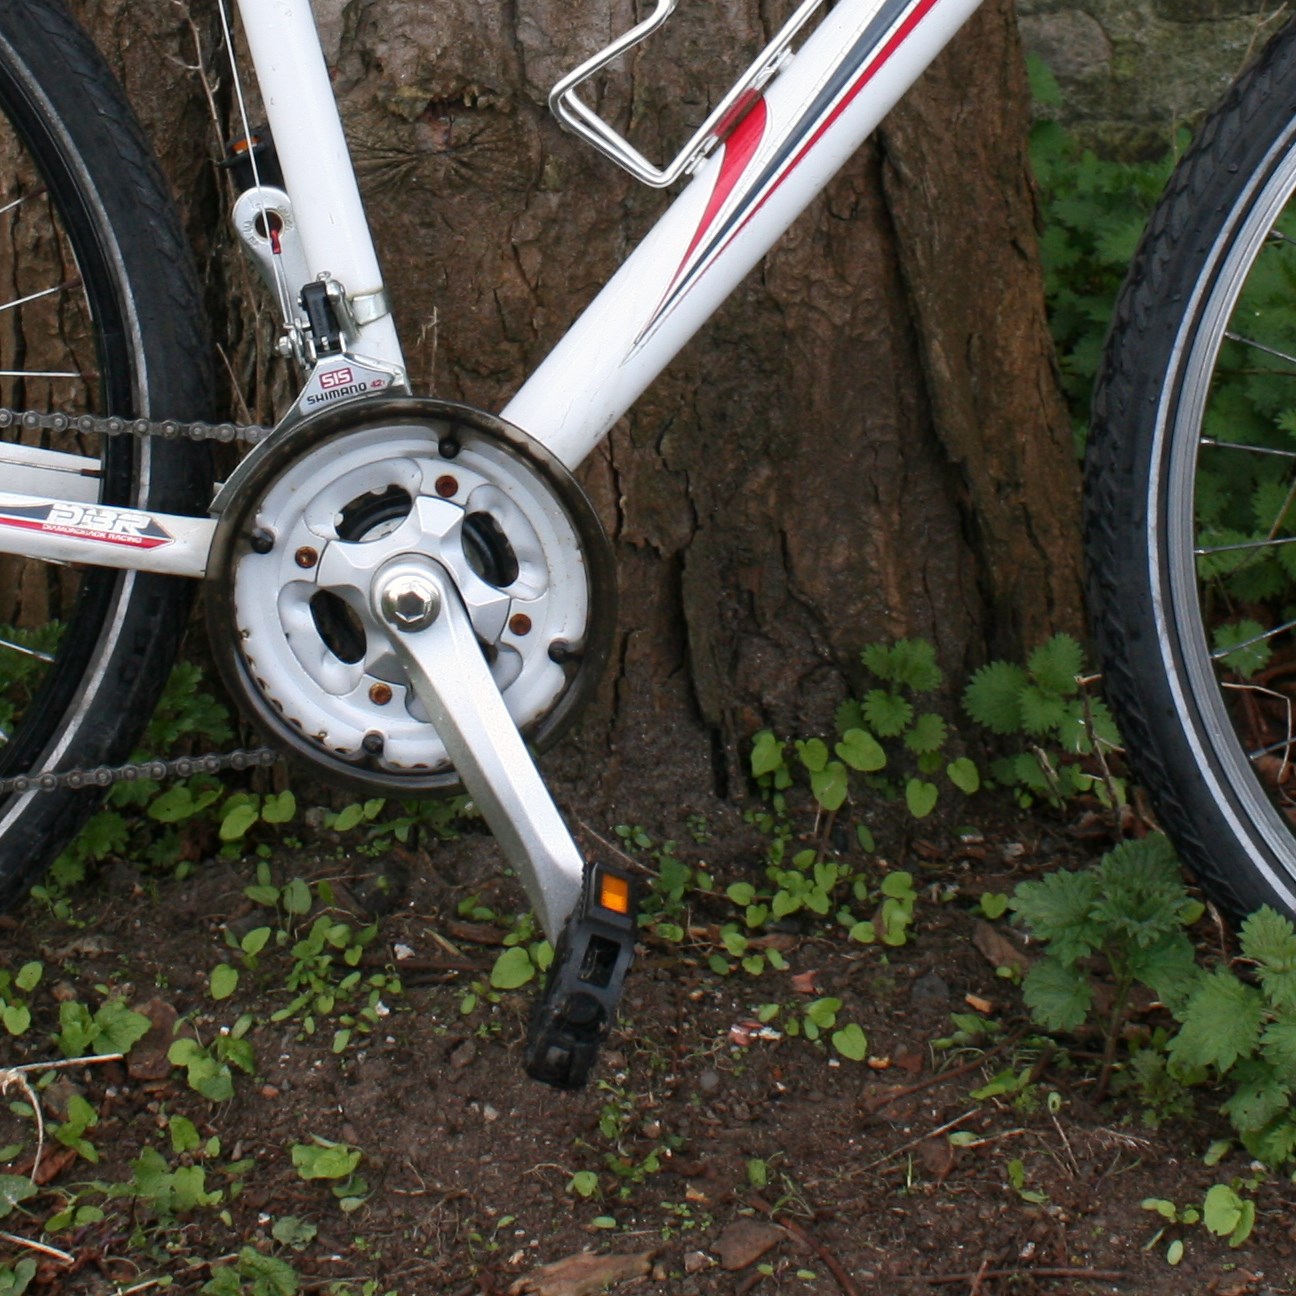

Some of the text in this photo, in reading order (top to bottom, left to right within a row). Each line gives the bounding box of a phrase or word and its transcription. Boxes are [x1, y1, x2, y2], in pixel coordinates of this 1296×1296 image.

[321, 370, 350, 387] SIS
[307, 382, 367, 405] SHIMANO
[45, 504, 151, 535] DBR
[107, 533, 143, 544] RACING
